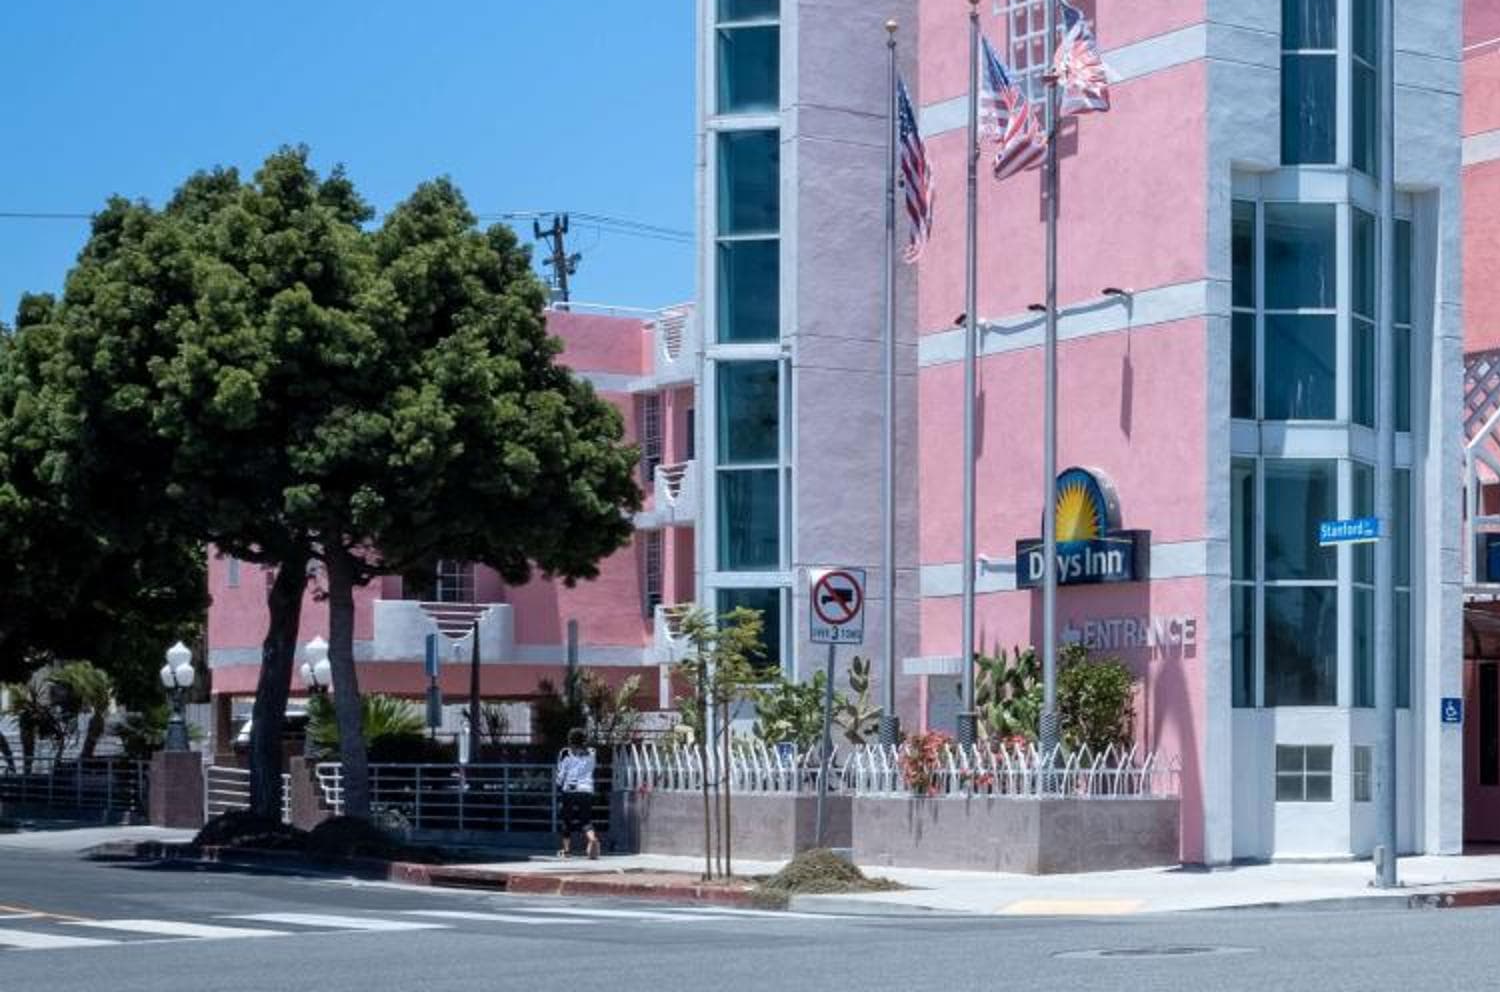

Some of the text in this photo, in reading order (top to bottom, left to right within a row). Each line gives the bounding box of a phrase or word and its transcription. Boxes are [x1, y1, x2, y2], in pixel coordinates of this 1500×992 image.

[1320, 519, 1363, 539] Stanford
[1028, 547, 1121, 582] Dys Inn
[831, 624, 839, 640] 3
[1083, 613, 1197, 651] ENTRANCE
